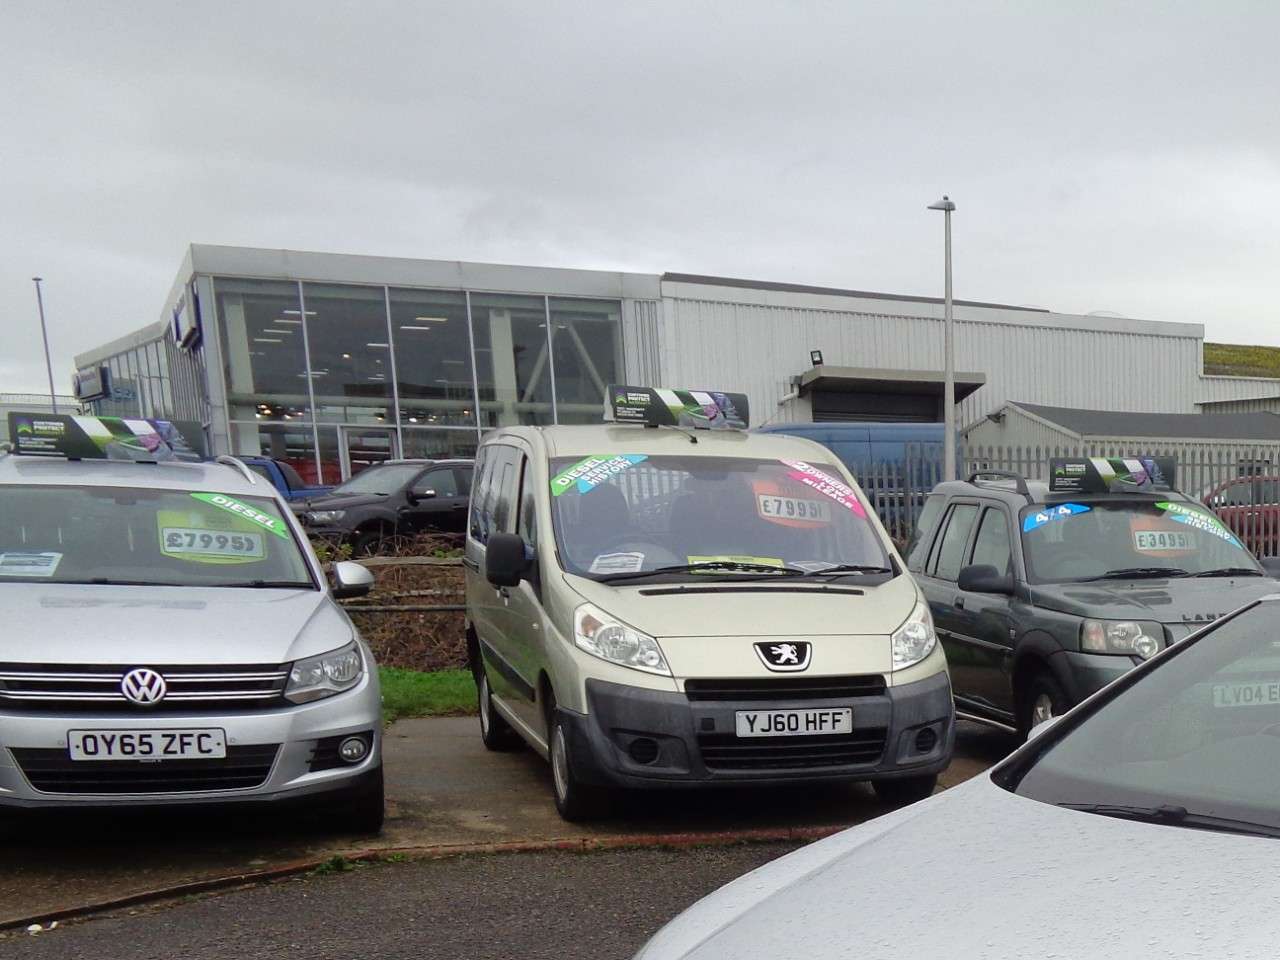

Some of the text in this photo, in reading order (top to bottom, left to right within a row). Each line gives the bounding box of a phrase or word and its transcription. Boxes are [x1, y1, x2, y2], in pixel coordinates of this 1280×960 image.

[557, 458, 605, 485] DIESEL
[588, 460, 633, 486] HISTORY
[210, 495, 276, 528] DIESEL
[745, 711, 843, 733] YJ60 HFF
[82, 733, 213, 756] OY65 ZFC
